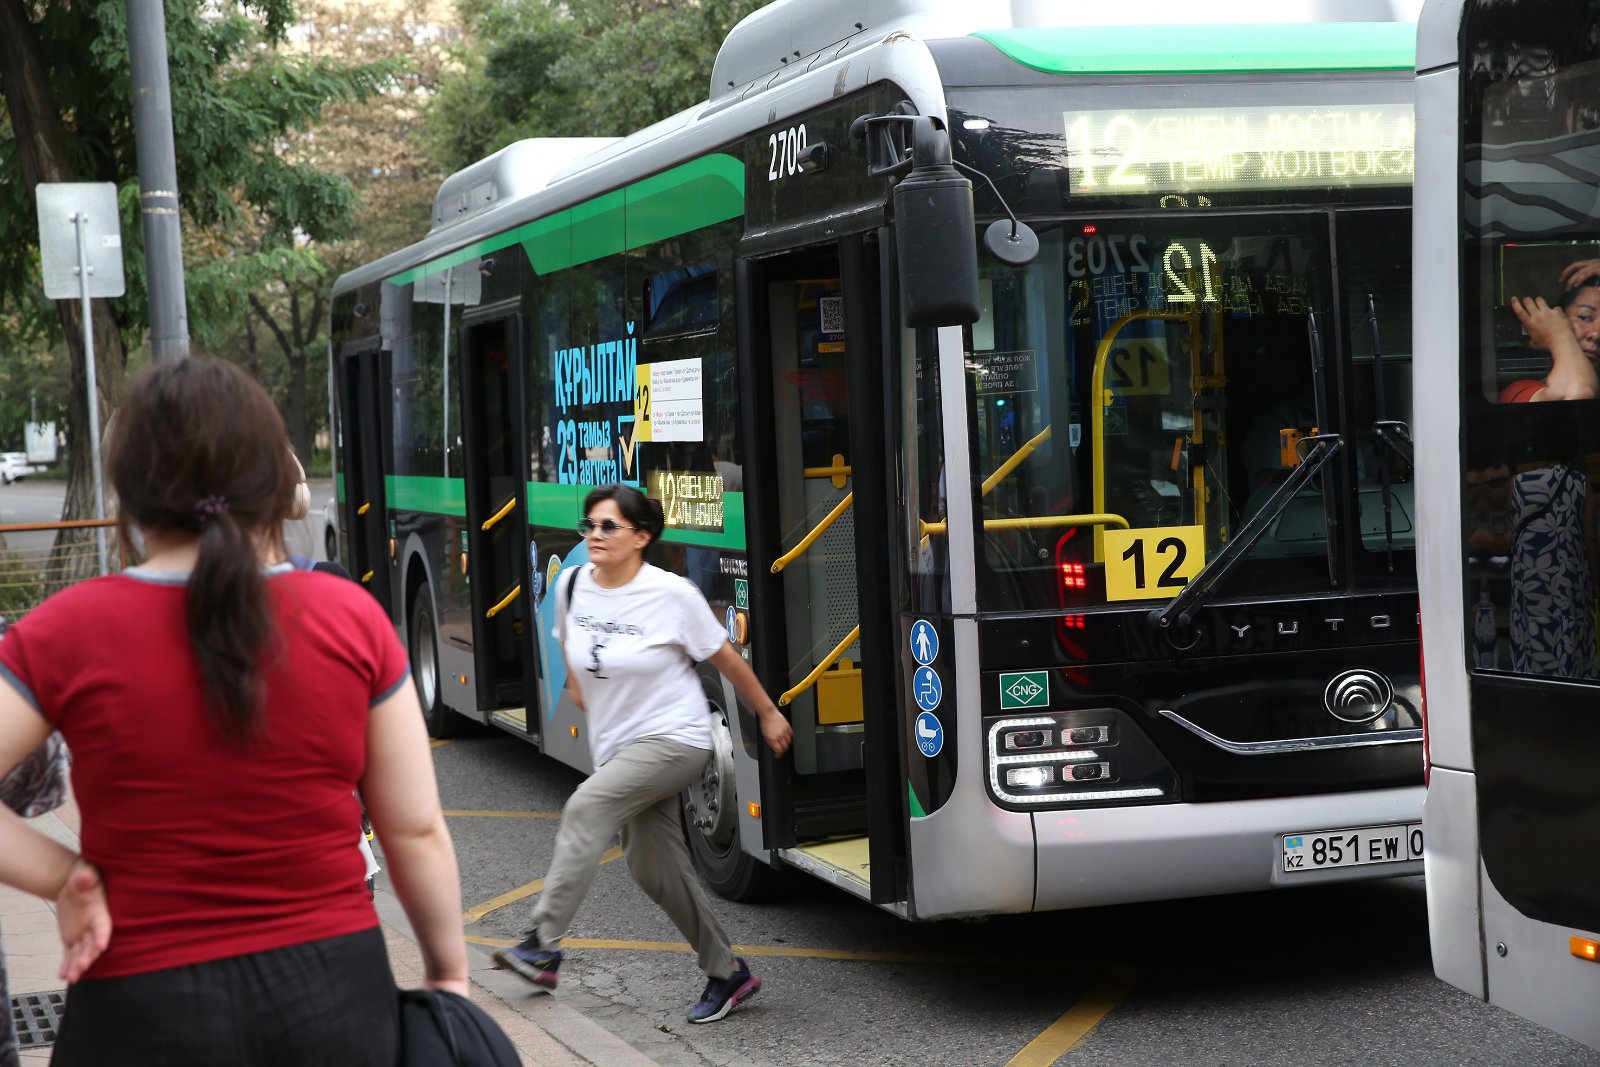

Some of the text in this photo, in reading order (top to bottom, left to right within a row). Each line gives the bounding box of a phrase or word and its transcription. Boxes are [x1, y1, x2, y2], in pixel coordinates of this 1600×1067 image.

[1070, 115, 1147, 186] 12
[554, 320, 638, 415] ҚҰРЫЛТАЙ
[636, 384, 650, 422] 12
[557, 418, 578, 486] 23
[578, 420, 611, 448] тамыз
[579, 459, 617, 486] августа
[658, 472, 677, 525] 12
[1122, 536, 1189, 590] 12
[1230, 613, 1420, 638] YUTO
[1012, 684, 1038, 697] CNG
[1286, 855, 1304, 868] KZ
[1311, 834, 1360, 866] 851
[1369, 836, 1399, 861] EW
